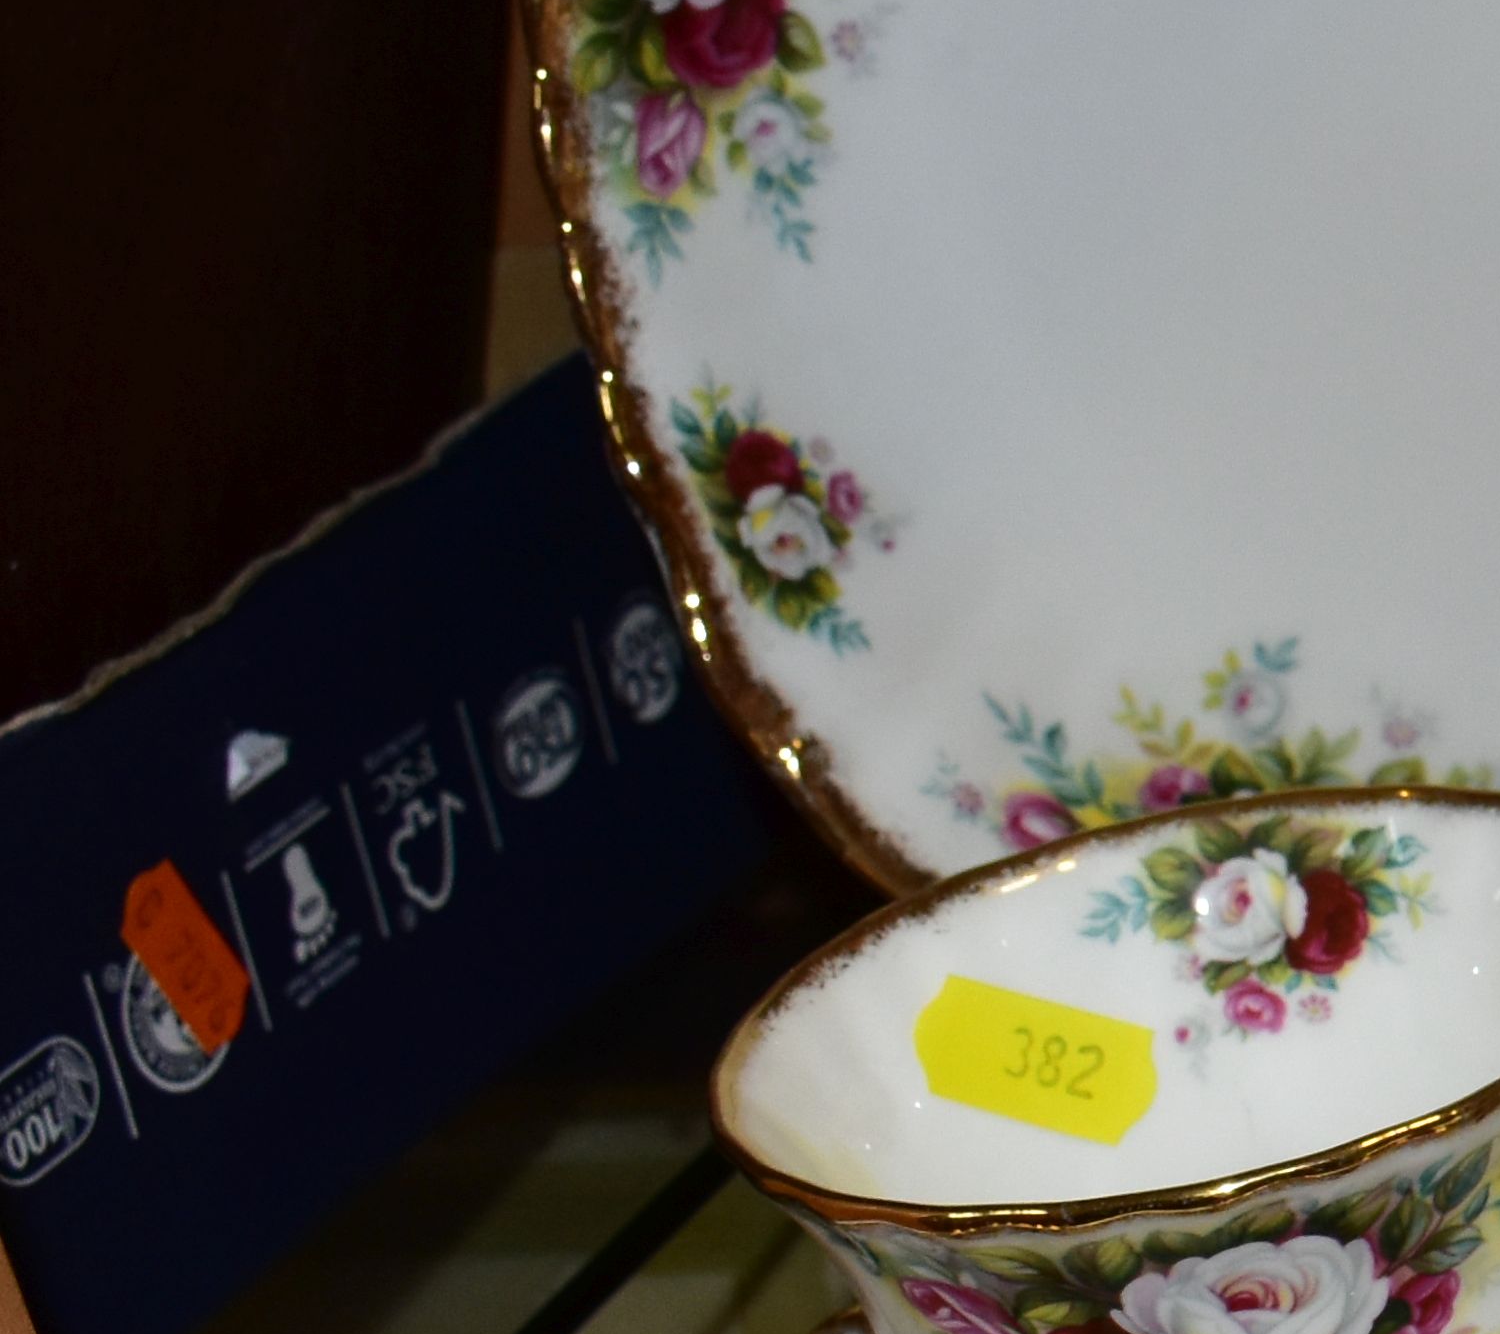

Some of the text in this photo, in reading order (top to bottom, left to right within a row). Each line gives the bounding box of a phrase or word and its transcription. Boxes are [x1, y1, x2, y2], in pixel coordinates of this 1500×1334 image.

[372, 743, 438, 815] FSC
[1004, 1027, 1106, 1100] 382
[5, 1105, 65, 1169] 100
